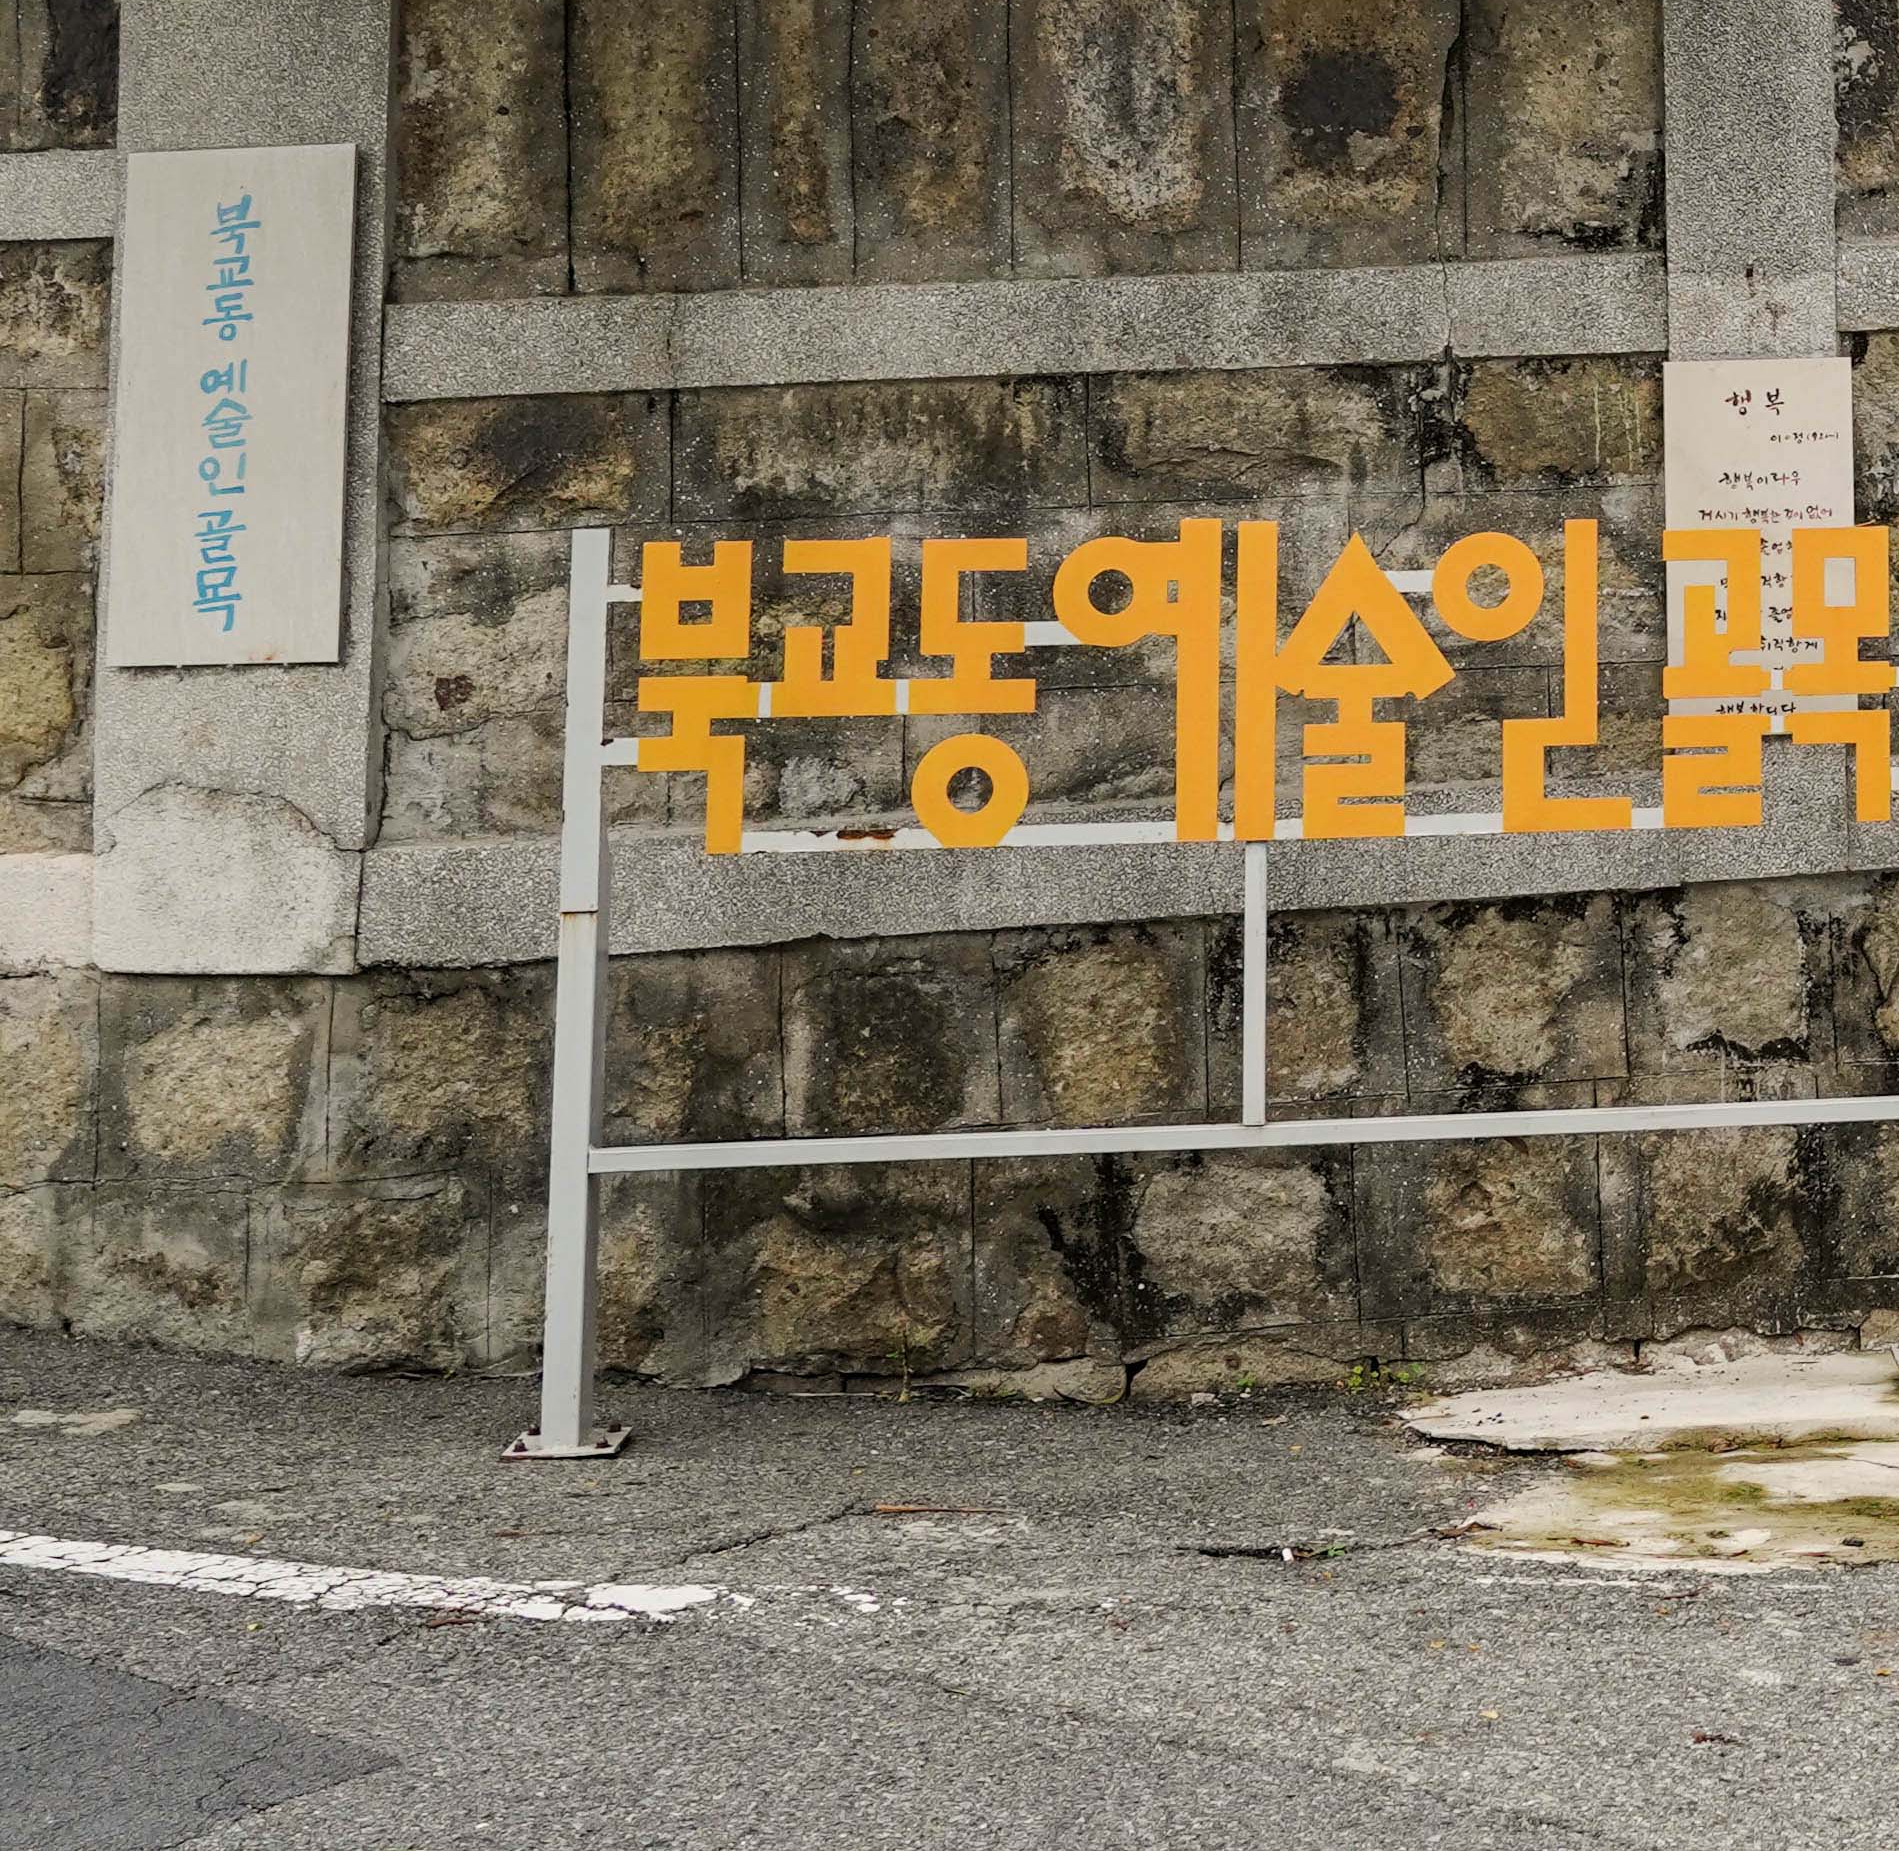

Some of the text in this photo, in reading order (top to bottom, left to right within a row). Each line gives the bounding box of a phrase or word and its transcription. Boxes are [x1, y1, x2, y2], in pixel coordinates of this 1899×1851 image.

[193, 193, 261, 633] 북교동 예술인 골목
